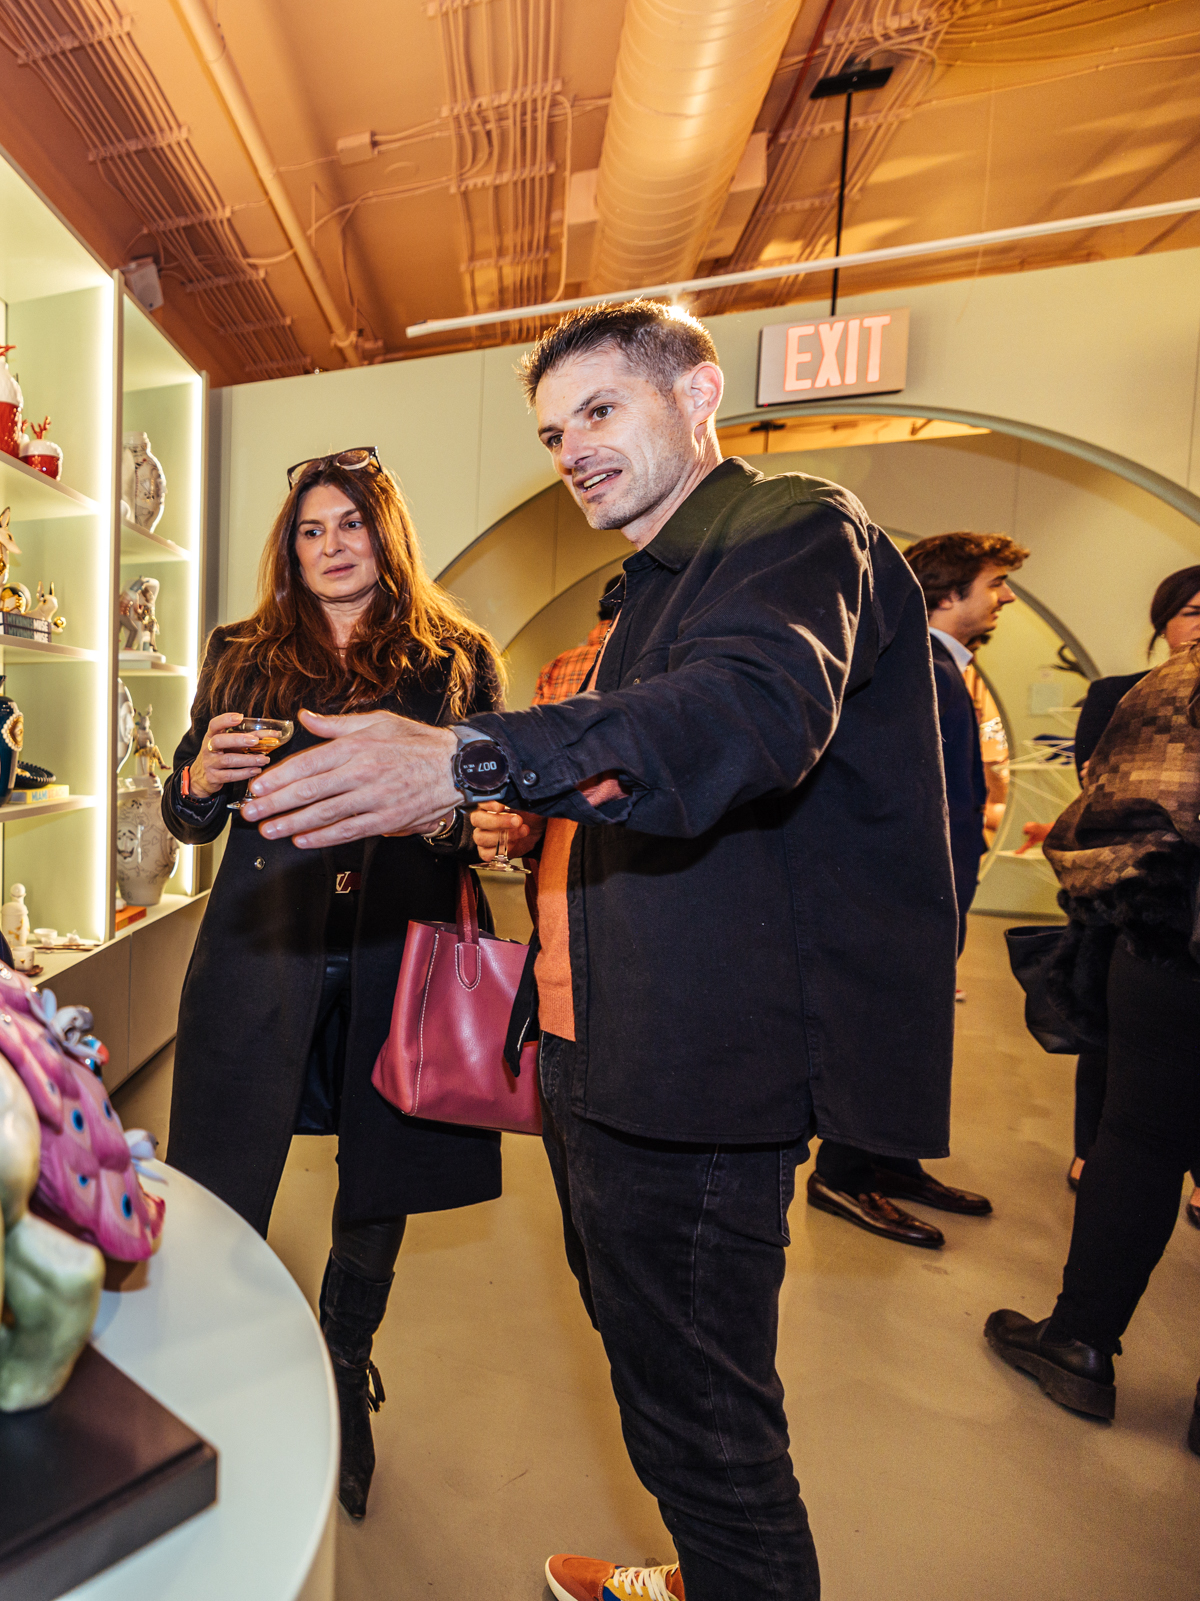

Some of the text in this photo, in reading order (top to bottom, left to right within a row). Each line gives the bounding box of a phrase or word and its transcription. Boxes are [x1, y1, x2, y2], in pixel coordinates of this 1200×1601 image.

[784, 315, 891, 392] EXIT
[34, 618, 49, 632] MUSE
[34, 630, 49, 643] MUSE
[32, 789, 48, 802] MIAMI
